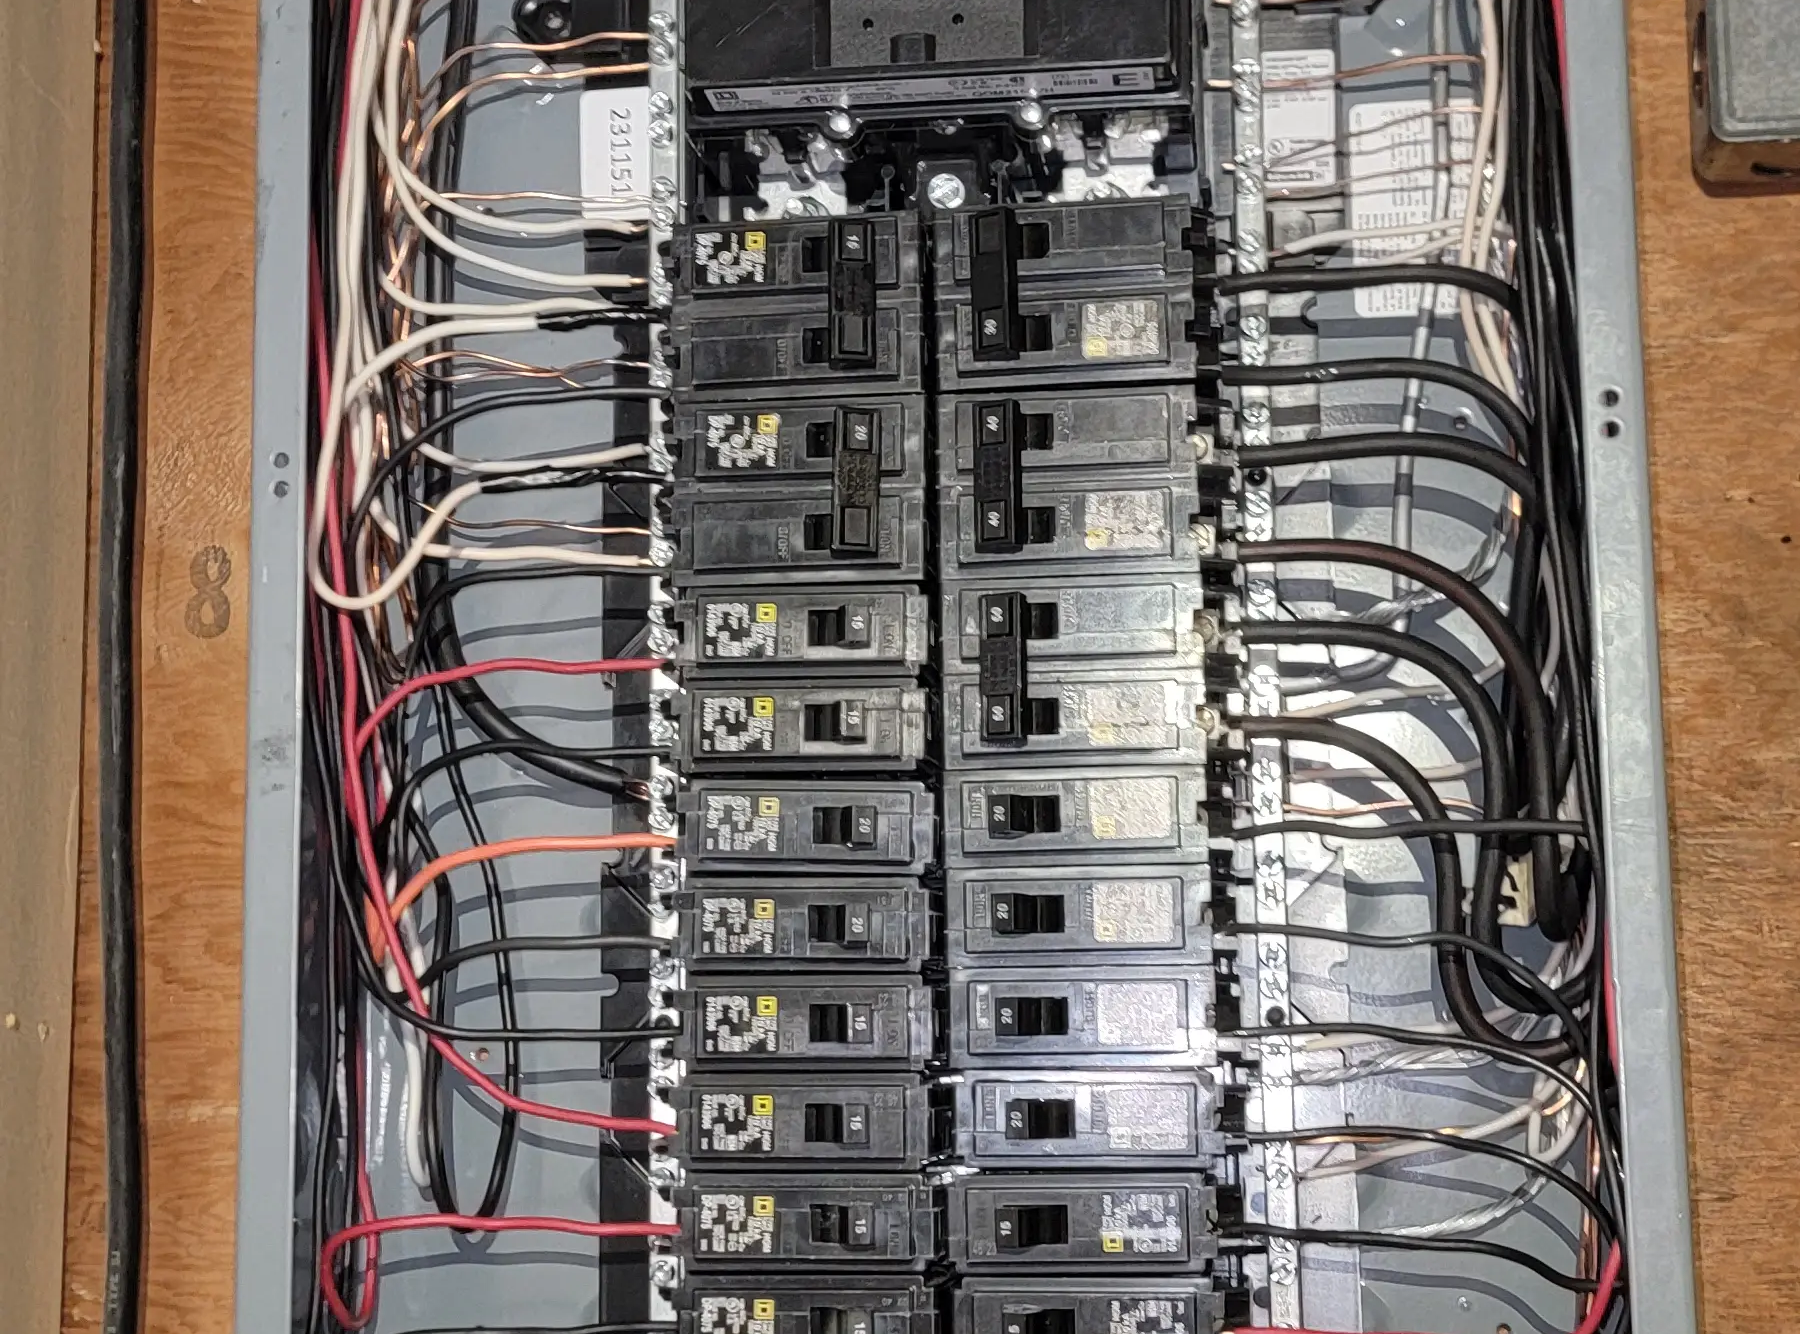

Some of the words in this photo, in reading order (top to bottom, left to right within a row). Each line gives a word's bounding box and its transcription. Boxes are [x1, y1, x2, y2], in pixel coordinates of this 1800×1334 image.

[609, 108, 633, 195] 231151
[854, 424, 868, 441] 20
[184, 545, 232, 639] 8
[993, 805, 1006, 822] 20
[858, 817, 872, 834] 20
[996, 903, 1010, 920] 20
[851, 917, 864, 933] 20
[854, 1015, 867, 1031] 15
[1000, 1007, 1013, 1025] 20
[850, 1115, 863, 1131] 15
[1010, 1111, 1023, 1128] 20
[855, 1218, 868, 1234] 15
[999, 1220, 1012, 1236] 15
